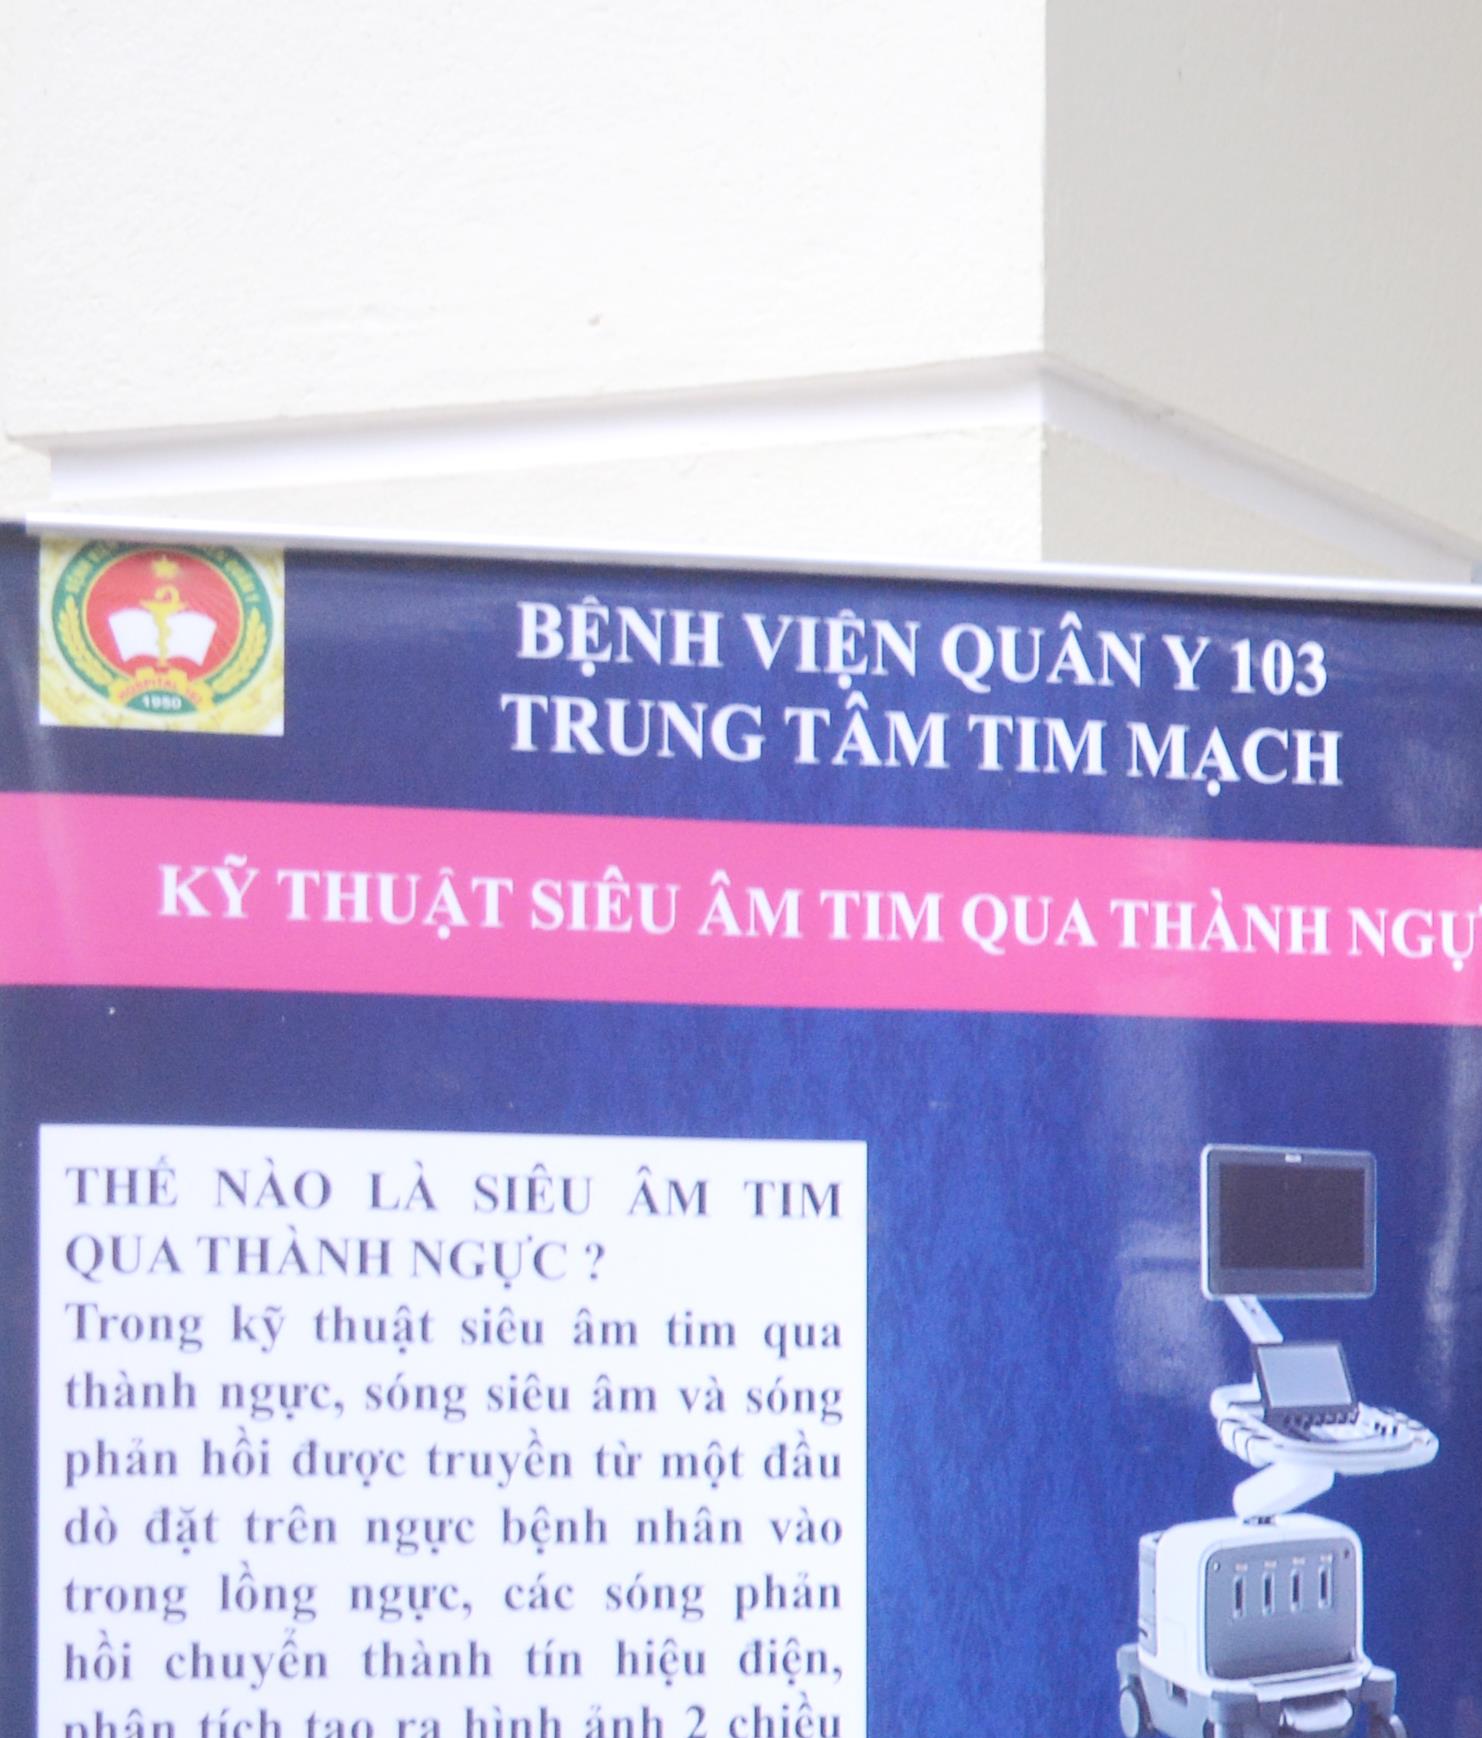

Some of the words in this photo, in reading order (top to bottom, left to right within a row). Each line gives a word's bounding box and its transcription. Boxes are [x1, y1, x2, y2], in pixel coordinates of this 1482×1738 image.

[518, 595, 722, 677] BỆNH
[743, 609, 919, 690] VIỆN
[941, 611, 1145, 693] QUÂN
[1163, 635, 1211, 691] Y
[1231, 639, 1327, 696] 103
[500, 694, 764, 762] TRUNG
[784, 700, 948, 768] TÂM
[968, 715, 1106, 775] TIM
[1127, 722, 1342, 796] MẠCH
[161, 854, 258, 918] KỸ
[277, 868, 513, 939] THUẬT
[531, 865, 678, 934] SIÊU
[699, 870, 800, 938] ÂM
[820, 890, 941, 941] TIM
[962, 894, 1096, 955] QUA
[1110, 888, 1329, 954] THÀNH
[65, 1155, 177, 1207] THẾ
[216, 1157, 332, 1211] NÀO
[370, 1160, 437, 1211] LÀ
[474, 1162, 591, 1215] SIÊU
[628, 1164, 708, 1217] ÂM
[743, 1180, 840, 1219] TIM
[65, 1235, 182, 1283] QUA
[196, 1224, 391, 1277] THÀNH
[412, 1234, 567, 1291] NGỰC
[584, 1242, 605, 1281] ?
